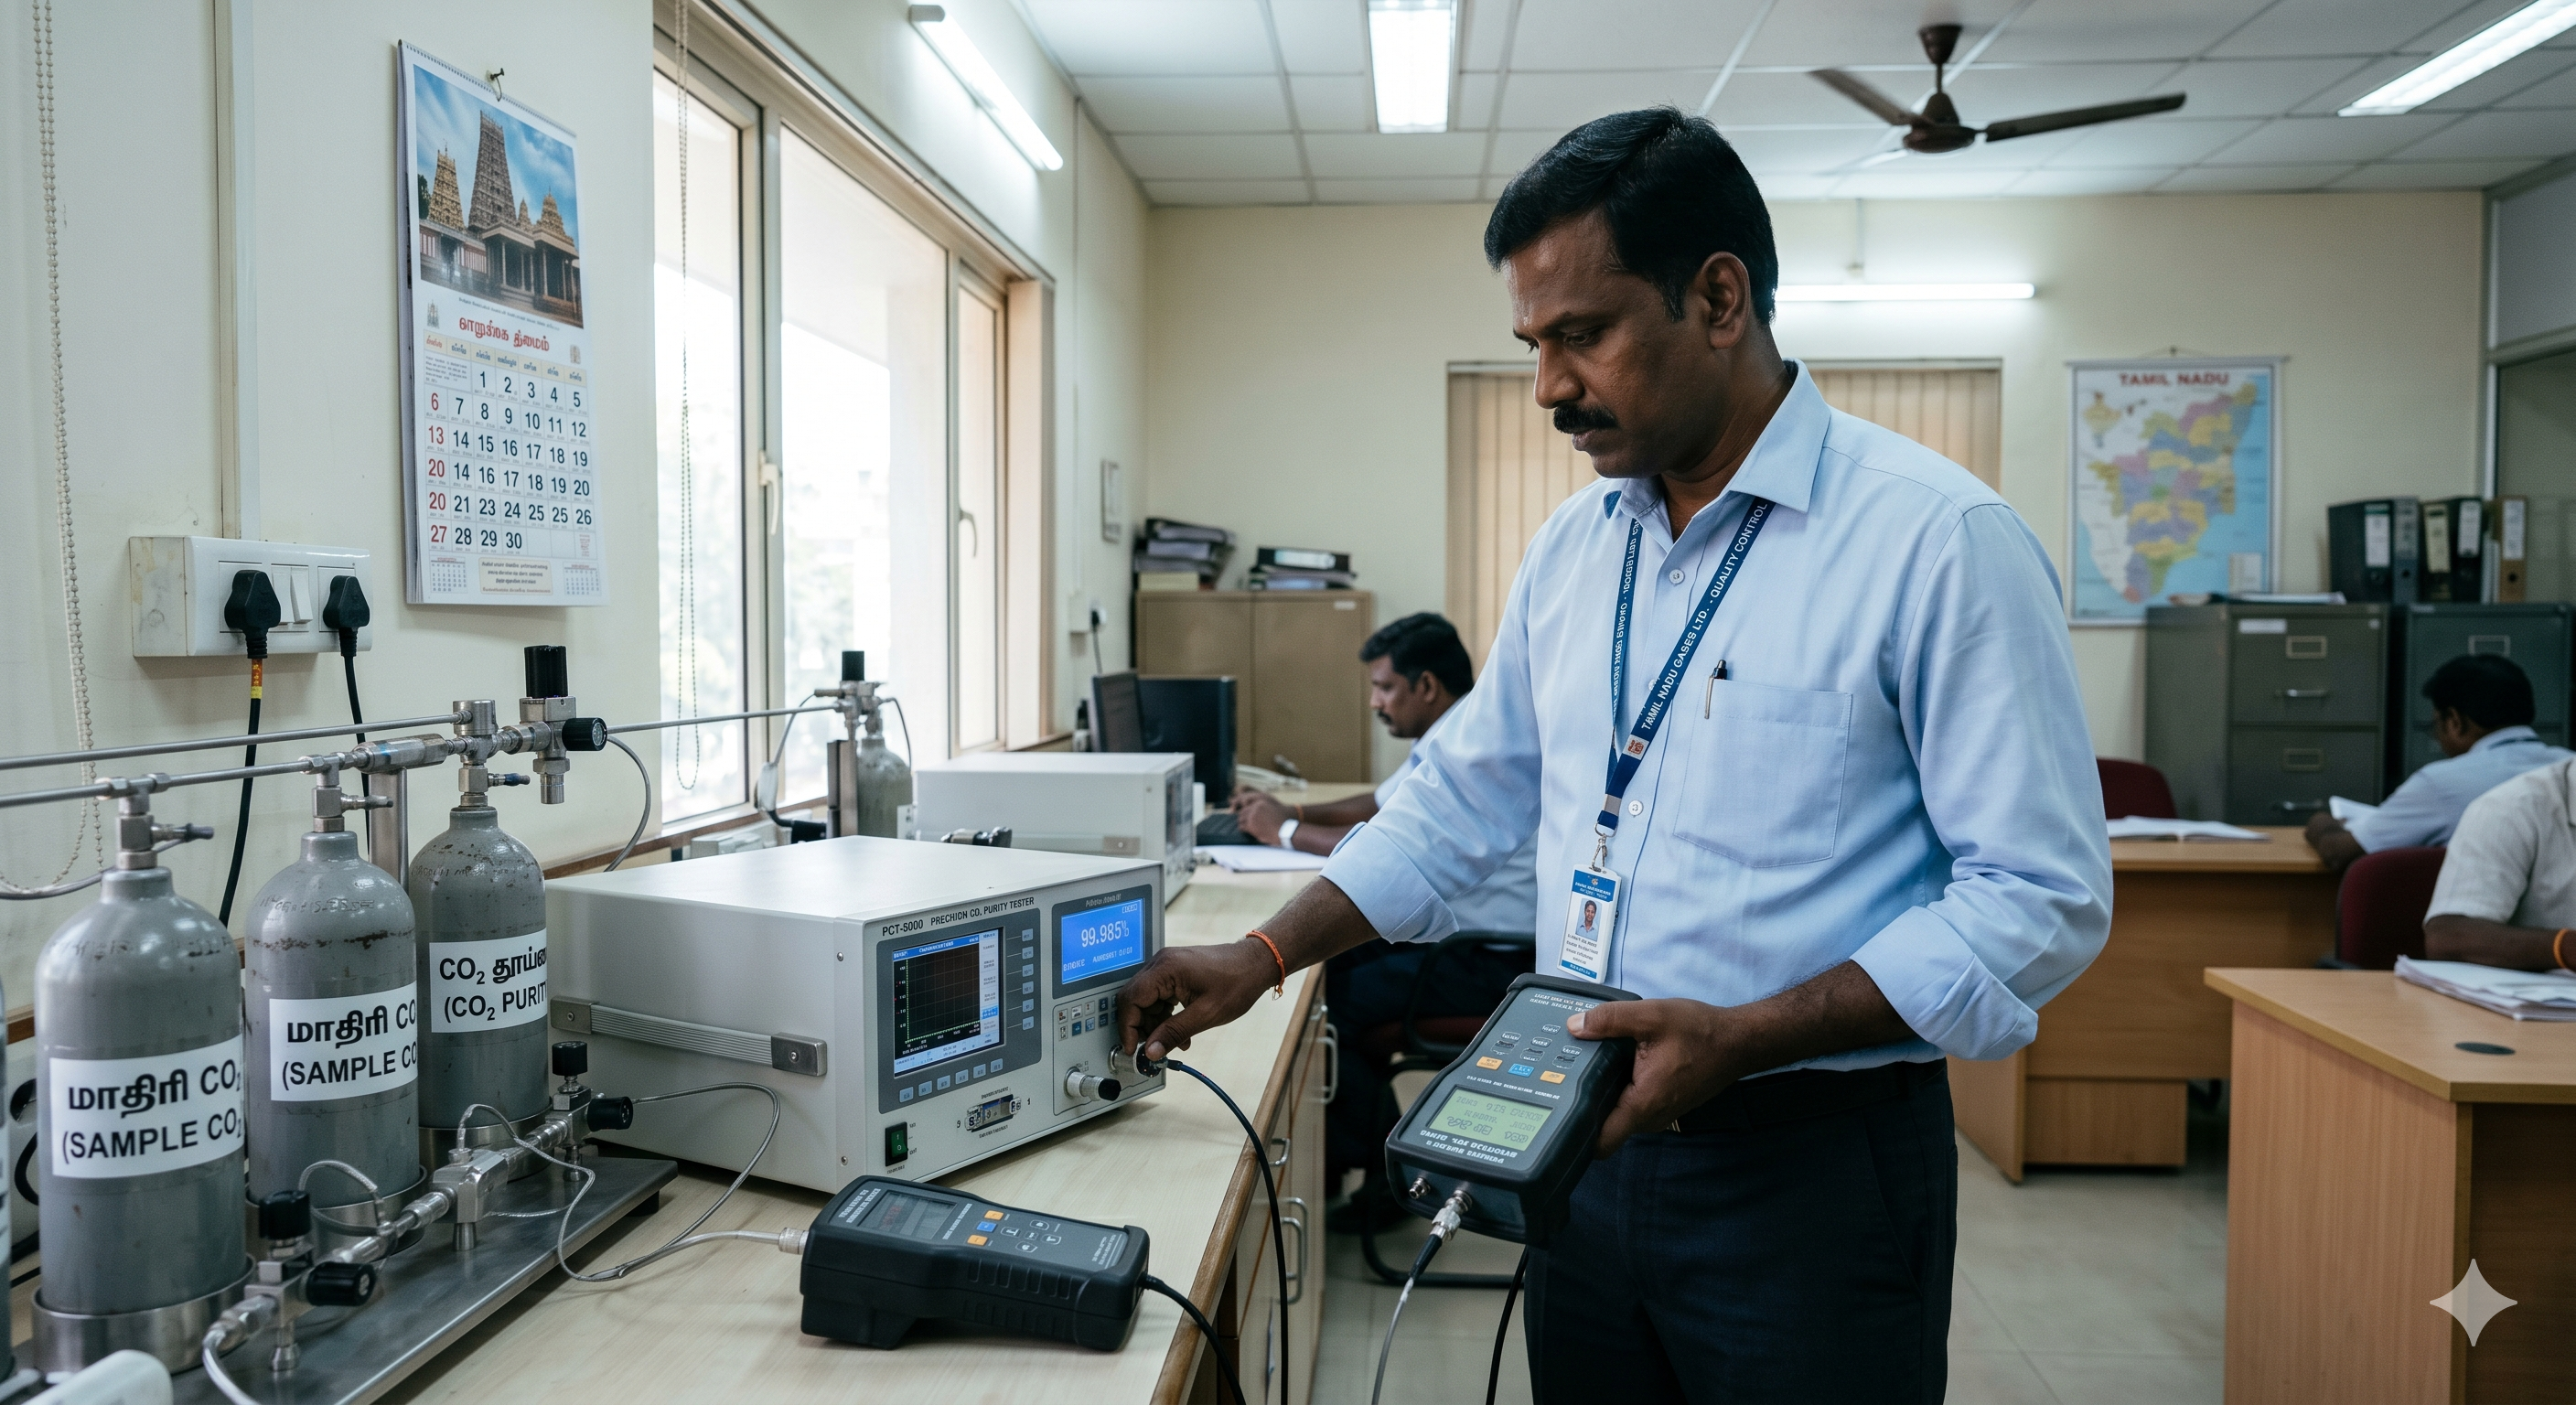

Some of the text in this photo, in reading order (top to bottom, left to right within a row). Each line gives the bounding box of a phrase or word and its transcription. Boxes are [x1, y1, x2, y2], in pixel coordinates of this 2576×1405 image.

[479, 371, 581, 407] 1 2 3 4 5
[2120, 372, 2229, 386] TAMIL NADU
[431, 392, 586, 437] 6 7 8 9 10 11 12
[428, 425, 587, 467] 13 14 15 16 17 18 19
[428, 458, 589, 496] 20 14 16 17 18 19 20
[429, 492, 591, 525] 20 21 23 24 25 25 26
[430, 525, 521, 549] 27 28 29 30
[1641, 698, 1664, 731] TAMIL
[1656, 668, 1678, 700] NADU
[1674, 631, 1697, 668] GASES
[1692, 607, 1710, 631] LTD.
[1711, 552, 1739, 598] QUALITY
[1734, 503, 1767, 552] CONTROL
[882, 919, 924, 937] PCT-5000
[983, 902, 1008, 916] PURITY
[1009, 896, 1035, 909] TESTER
[287, 1005, 388, 1049] மாதிரி
[282, 1050, 396, 1090] (SAMPLE
[69, 1068, 188, 1119] மாதிரி
[62, 1121, 199, 1164] (SAMPLE
